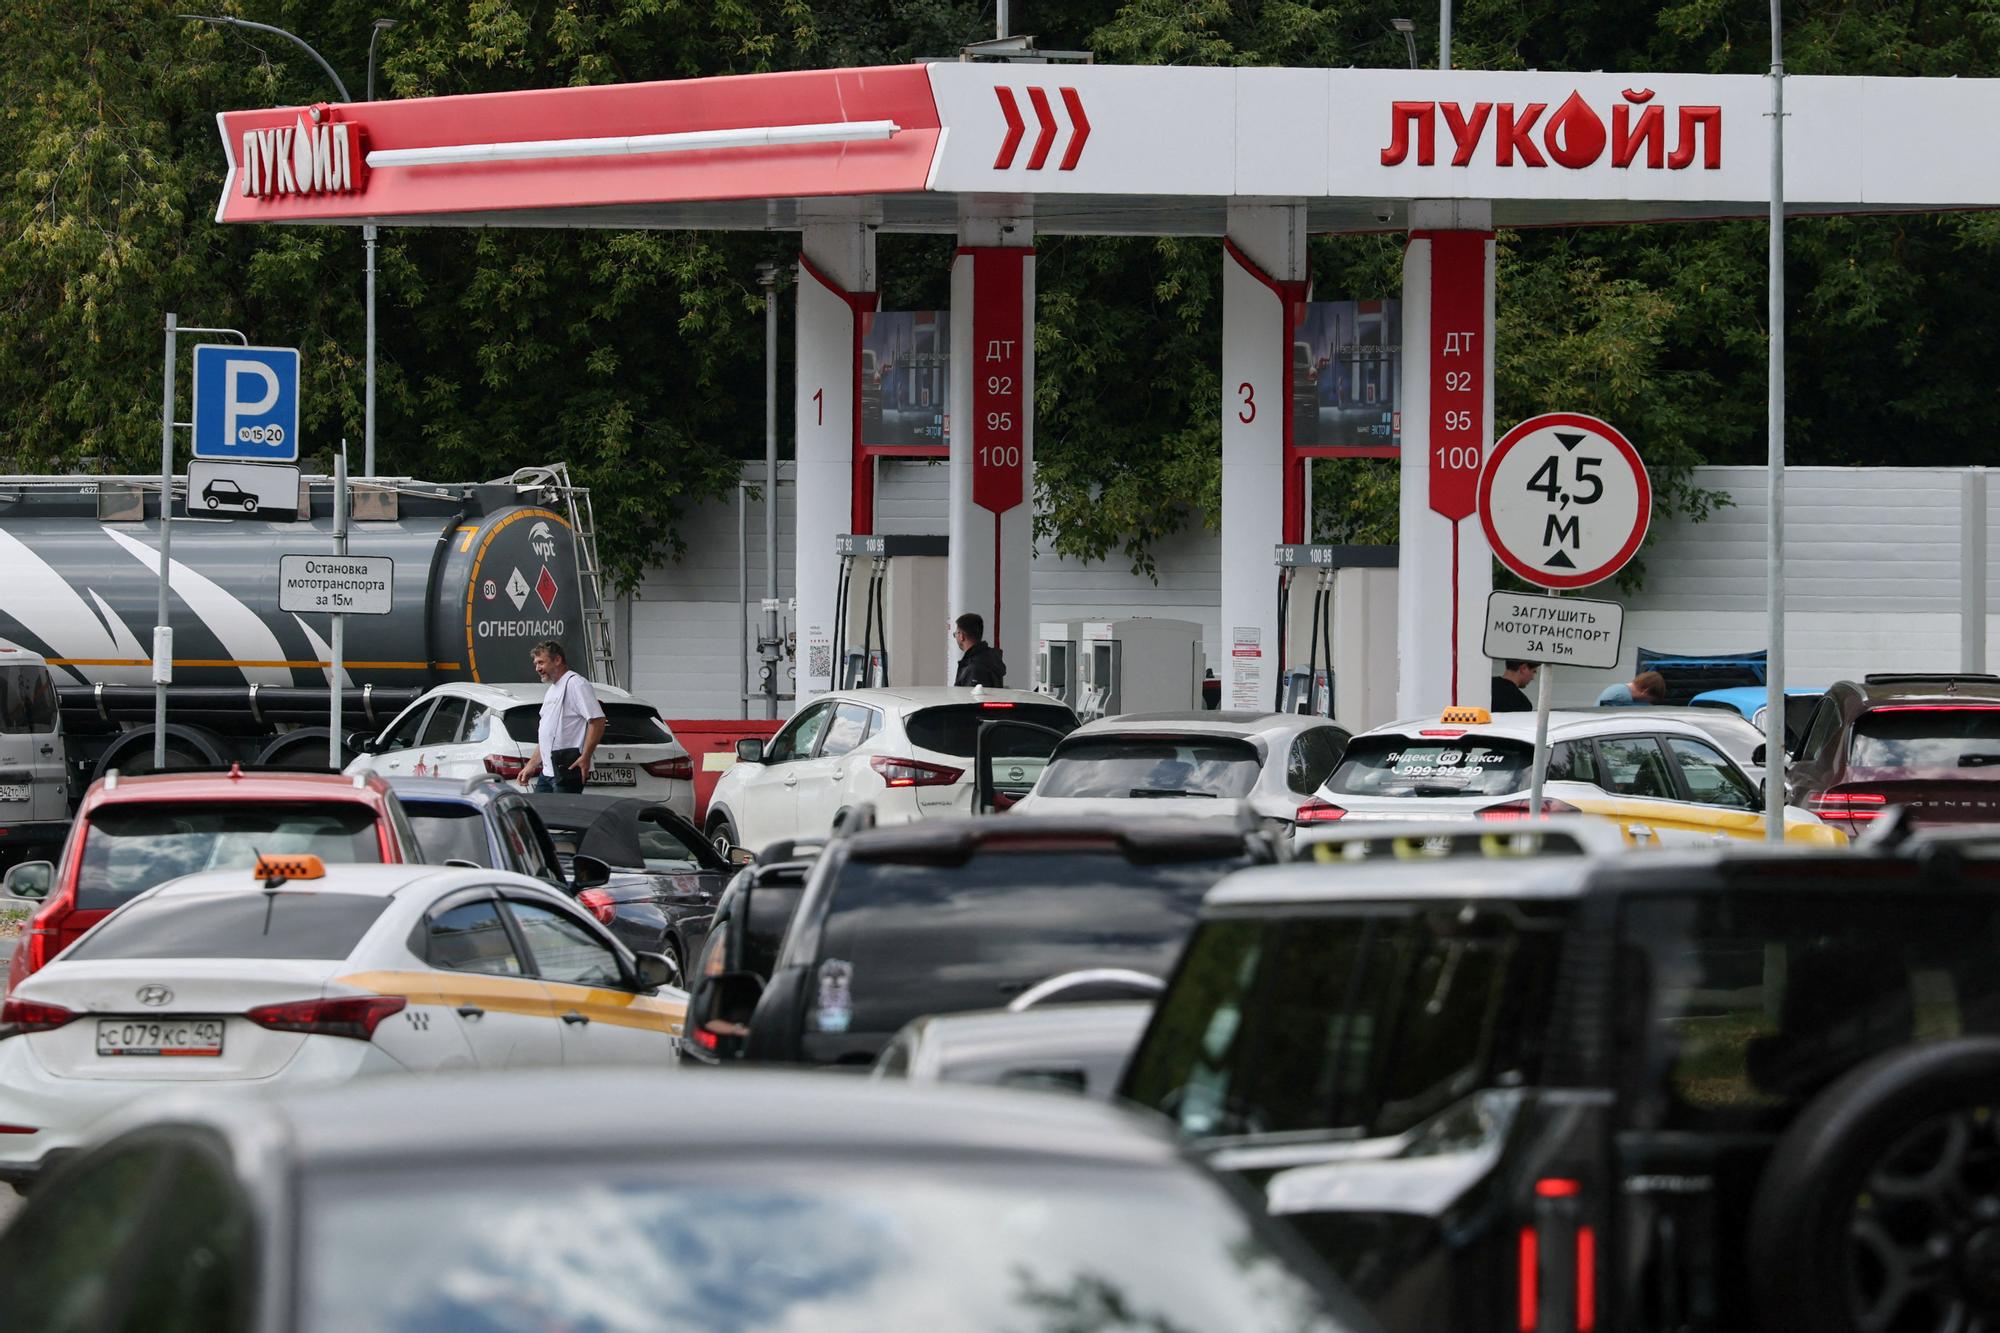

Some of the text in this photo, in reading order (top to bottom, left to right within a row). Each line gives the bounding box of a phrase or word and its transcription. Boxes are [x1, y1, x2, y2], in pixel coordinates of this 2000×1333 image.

[1381, 88, 1721, 169] ЛУКОЙЛ
[242, 103, 351, 197] ЛУКОЙЛ
[986, 340, 1015, 362] ДТ
[1443, 332, 1475, 357] ДТ
[988, 376, 1012, 395] 92
[1445, 371, 1471, 392] 92
[224, 360, 280, 445] P
[813, 388, 823, 426] 1
[1238, 382, 1256, 424] 3
[987, 412, 1012, 431] 95
[1445, 411, 1471, 431] 95
[241, 429, 283, 441] 10 15 20
[979, 446, 1019, 467] 100
[1436, 447, 1479, 469] 100
[1526, 456, 1603, 510] 4,5
[532, 540, 556, 562] wpt
[846, 538, 853, 551] 92
[866, 538, 876, 552] 100
[876, 538, 885, 552] 95
[1275, 548, 1332, 563] ДТ 92 100 95
[305, 561, 368, 575] Остановка
[287, 579, 385, 593] мототранспорта
[484, 583, 496, 596] 80
[315, 593, 353, 606] за 15м
[1512, 605, 1596, 624] ЗАГЛУШИТЬ
[478, 620, 564, 637] ОГНЕОПАСНО
[1494, 621, 1611, 642] МОТОТРАНСПОРТ
[1527, 641, 1544, 653] ЗА
[1386, 752, 1436, 762] Яндекс
[1464, 752, 1504, 763] Такси
[588, 769, 632, 782] 0НК 198
[1404, 766, 1483, 776] 999-99-99
[194, 1023, 215, 1040] 40
